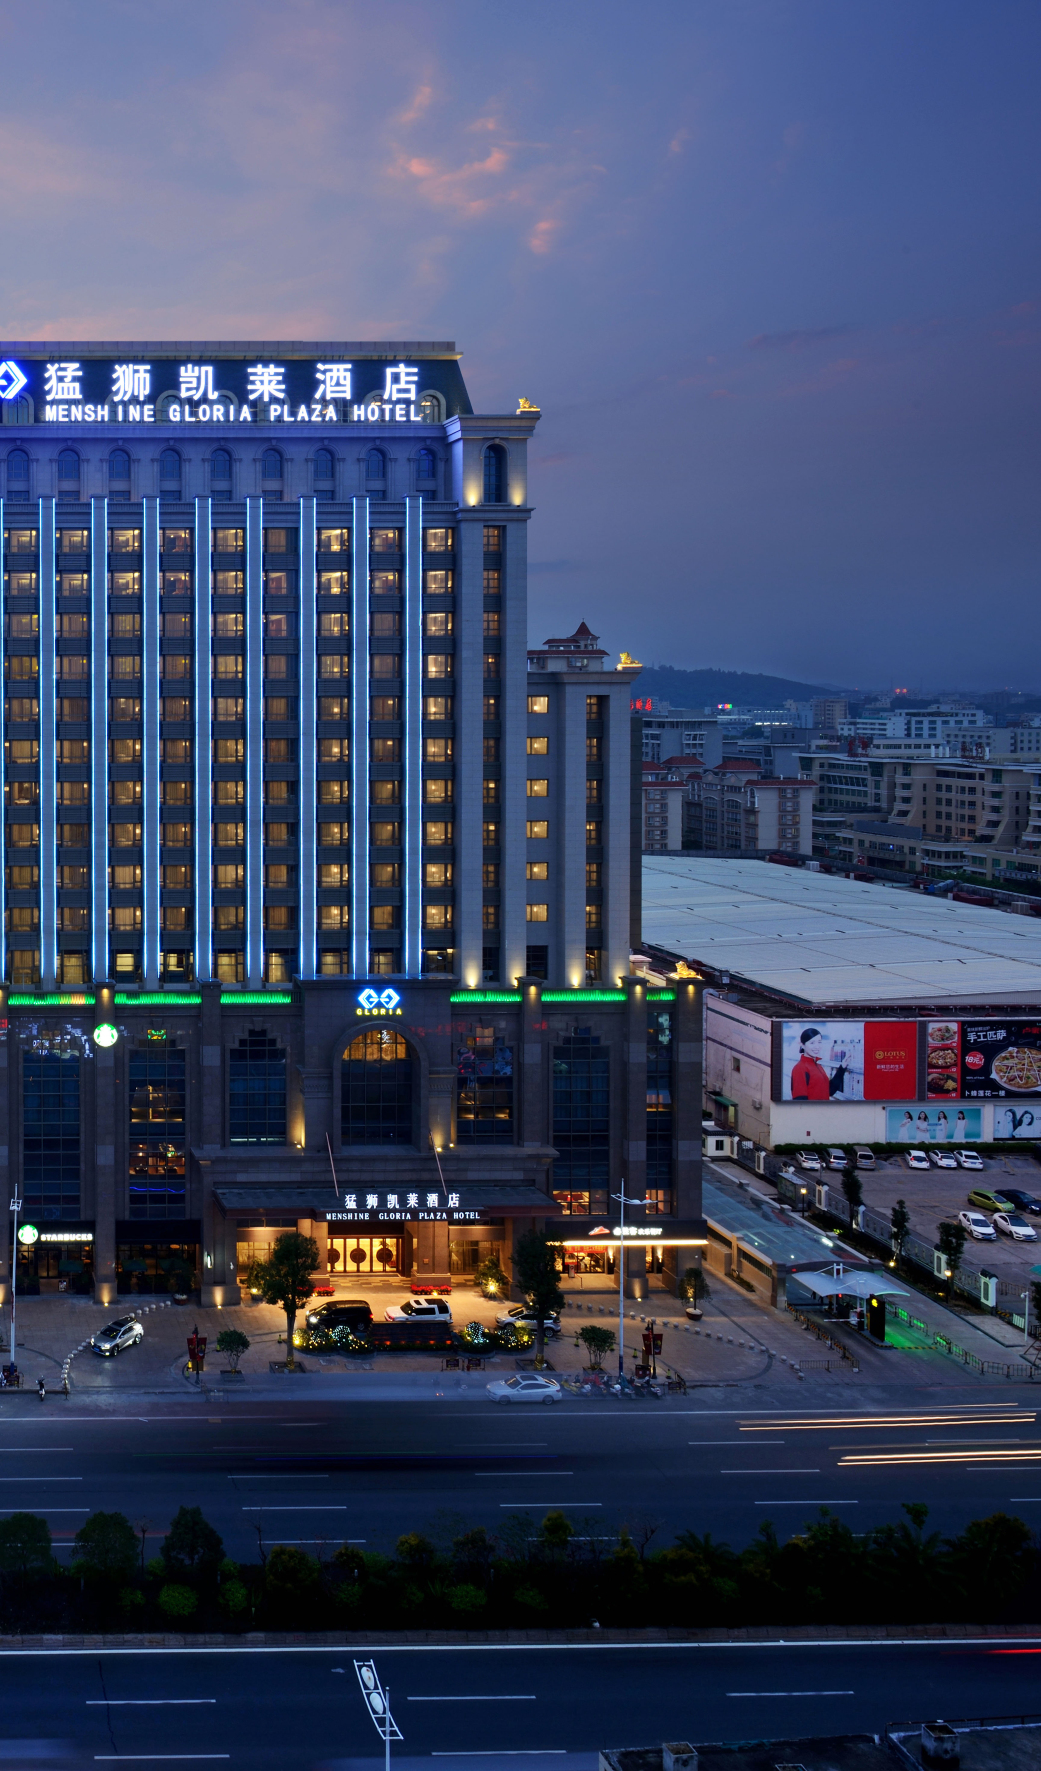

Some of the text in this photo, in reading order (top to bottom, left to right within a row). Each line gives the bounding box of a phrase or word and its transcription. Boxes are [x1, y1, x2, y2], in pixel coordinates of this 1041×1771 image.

[44, 363, 420, 401] 猛狮凯莱酒店
[169, 404, 252, 422] GLORIA
[270, 404, 338, 421] PLAZA
[353, 404, 422, 421] HOTEL
[356, 1007, 403, 1016] GLORIA
[967, 1029, 1007, 1043] 手工匹萨
[344, 1193, 460, 1209] 猛狮凯莱酒店
[326, 1211, 481, 1220] MENSHINE GLORIA PLAZA HOTEL
[40, 1233, 93, 1241] STARBUCKS
